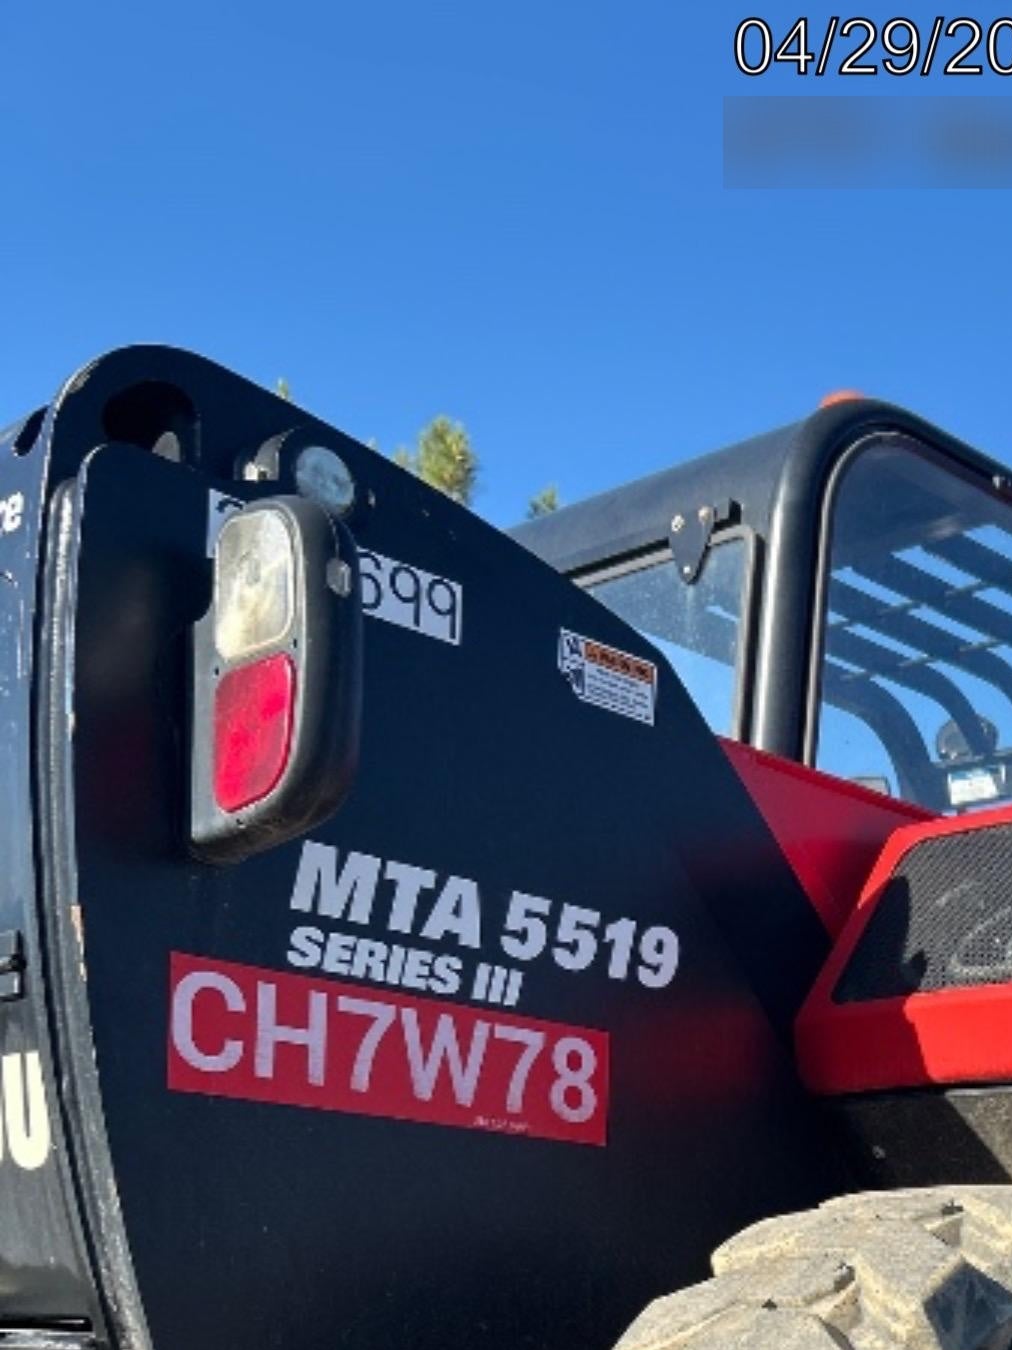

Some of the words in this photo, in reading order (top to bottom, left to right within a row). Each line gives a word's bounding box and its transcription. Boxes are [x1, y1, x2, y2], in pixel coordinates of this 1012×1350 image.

[286, 926, 463, 995] SERIES
[471, 964, 524, 1006] III
[290, 839, 481, 948] MTA
[500, 890, 680, 988] 5519
[0, 1051, 51, 1171] U
[171, 970, 598, 1124] CH7W78
